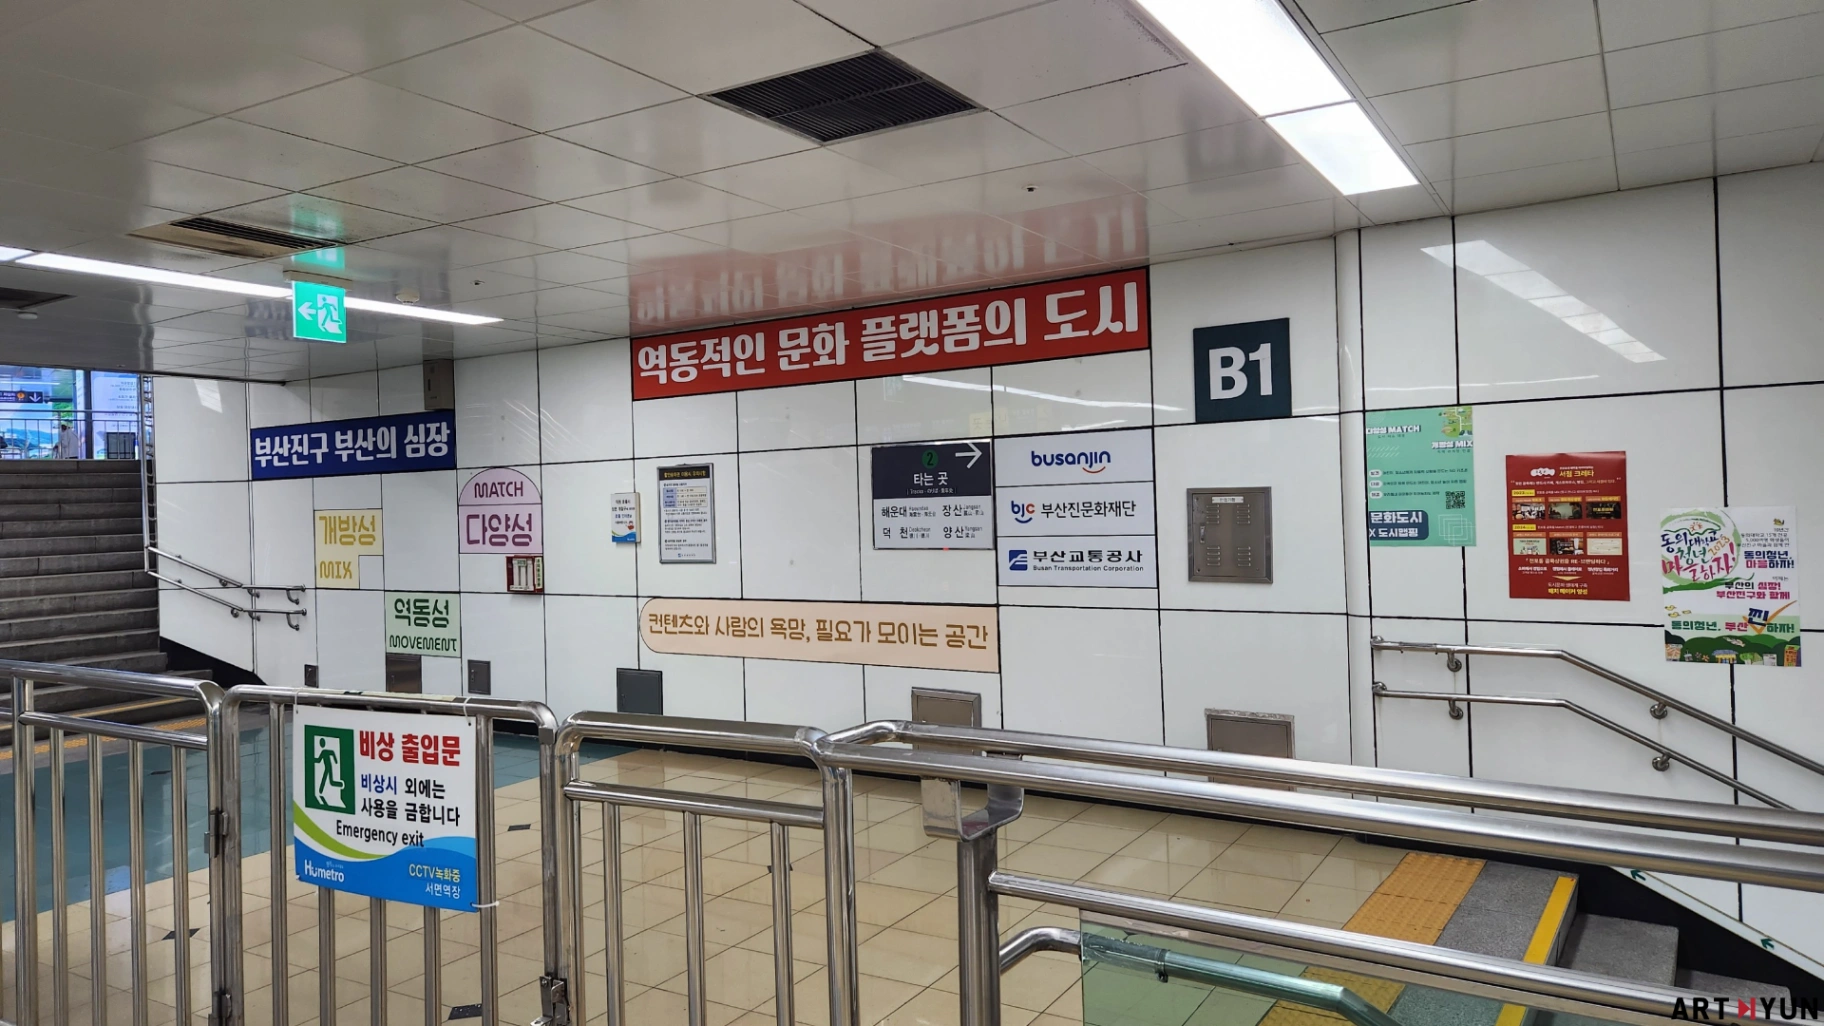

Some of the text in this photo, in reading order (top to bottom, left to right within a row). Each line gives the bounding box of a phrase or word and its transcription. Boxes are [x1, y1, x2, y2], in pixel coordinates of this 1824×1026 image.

[638, 281, 1140, 385] 역동적인 문화 플랫폼의 도시
[1208, 343, 1273, 400] B1
[1388, 425, 1421, 434] MATCH
[254, 422, 450, 468] 부산진구 부산의 심장
[1455, 440, 1473, 449] MIX
[1031, 450, 1111, 468] busanjin
[913, 471, 948, 486] 타는 곳
[474, 481, 524, 498] MATCH
[881, 505, 907, 518] 해운대
[1011, 501, 1136, 519] bjc 부산진문화재단
[1370, 511, 1422, 523] 문화도시
[319, 515, 376, 546] 개방성
[466, 513, 532, 547] 다양성
[1032, 550, 1143, 563] 부산교통공사
[319, 561, 352, 579] MIX
[1725, 582, 1754, 590] 부산의
[1716, 591, 1790, 600] 부산진구와 함께
[394, 598, 449, 628] 역동성
[648, 613, 988, 650] 컨텐츠와 사람의 욕망, 필요가 모이는 공간
[389, 634, 457, 651] MOVEMENT
[359, 730, 461, 766] 비상 출입문
[361, 774, 445, 799] 비상시 외에는
[361, 798, 460, 826] 사용을 금합니다
[336, 820, 424, 847] Emergency exit
[425, 883, 460, 899] 서면역장
